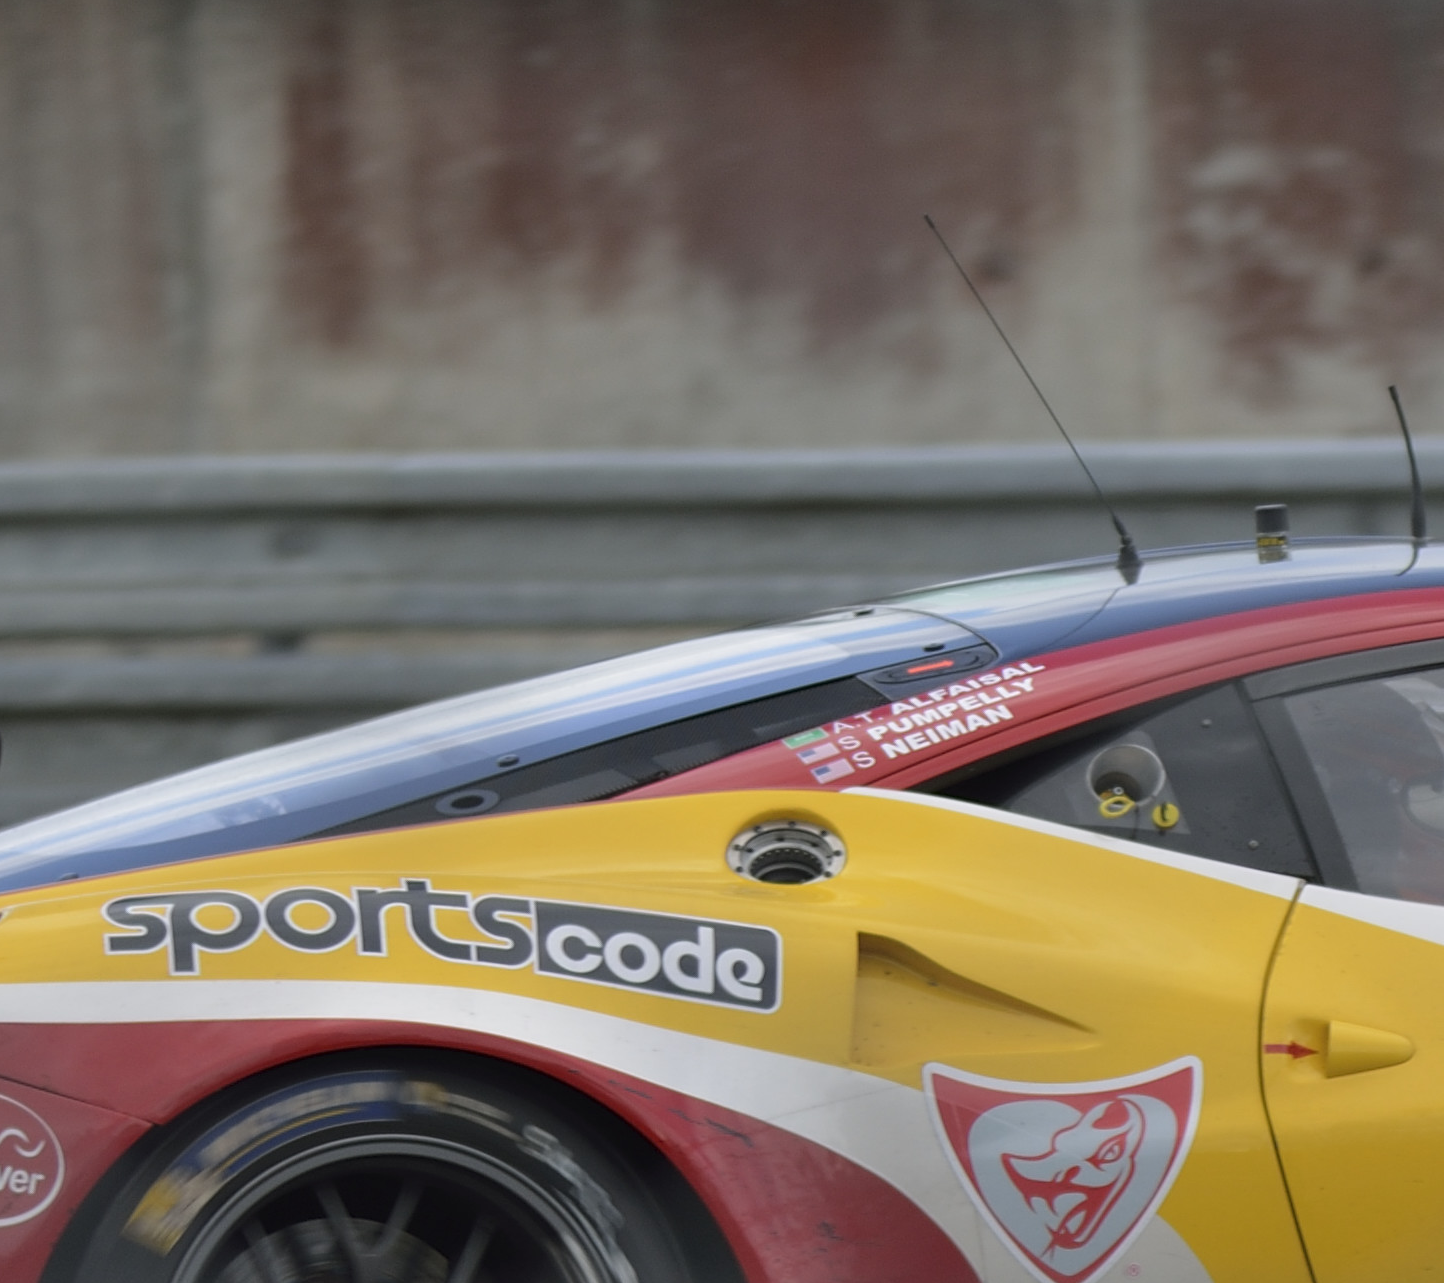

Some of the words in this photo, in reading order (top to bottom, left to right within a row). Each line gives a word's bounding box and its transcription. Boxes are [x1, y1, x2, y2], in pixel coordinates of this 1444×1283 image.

[838, 735, 861, 751] S
[866, 678, 1035, 741] PUMPELLY
[891, 663, 1045, 715] ALFAISAL
[852, 751, 876, 769] S
[881, 705, 1014, 759] NEIMAN
